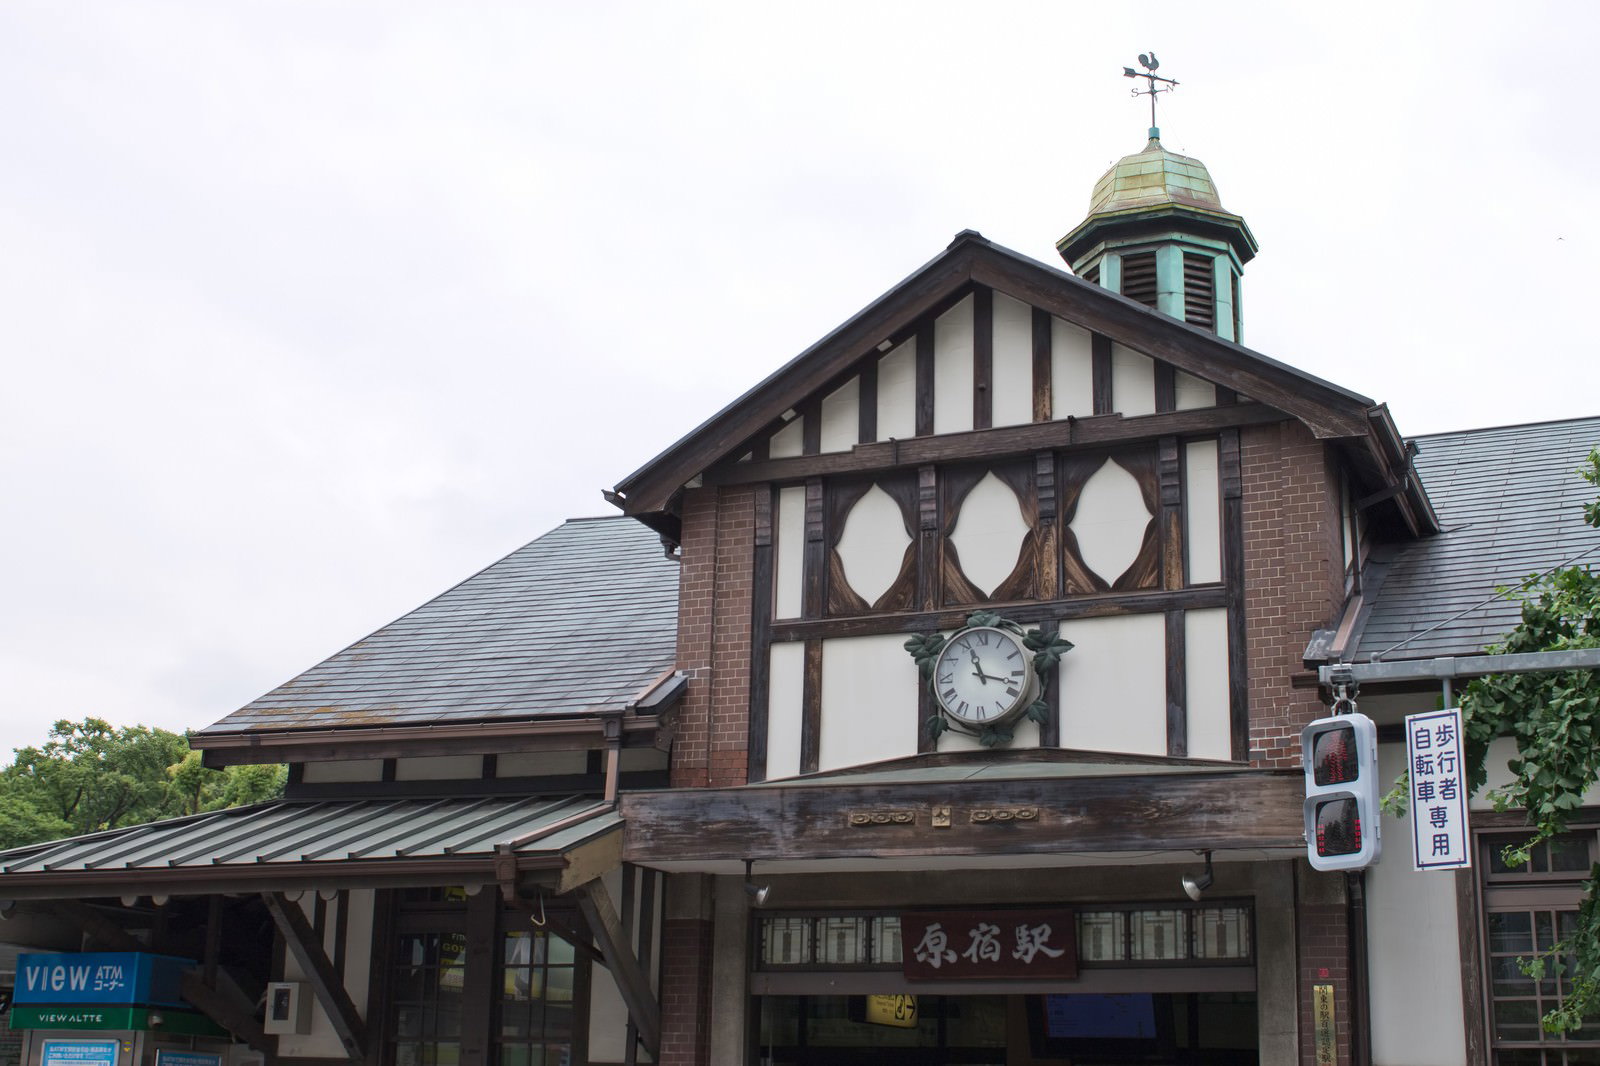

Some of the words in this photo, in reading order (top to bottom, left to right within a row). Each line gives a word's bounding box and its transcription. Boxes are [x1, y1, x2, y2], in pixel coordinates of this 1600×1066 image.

[1415, 728, 1435, 803] 自転車
[1435, 724, 1457, 801] 歩行者
[1429, 806, 1450, 856] 専用
[913, 922, 1065, 969] 原宿駅
[94, 980, 124, 991] コーナー
[95, 966, 122, 979] ATM
